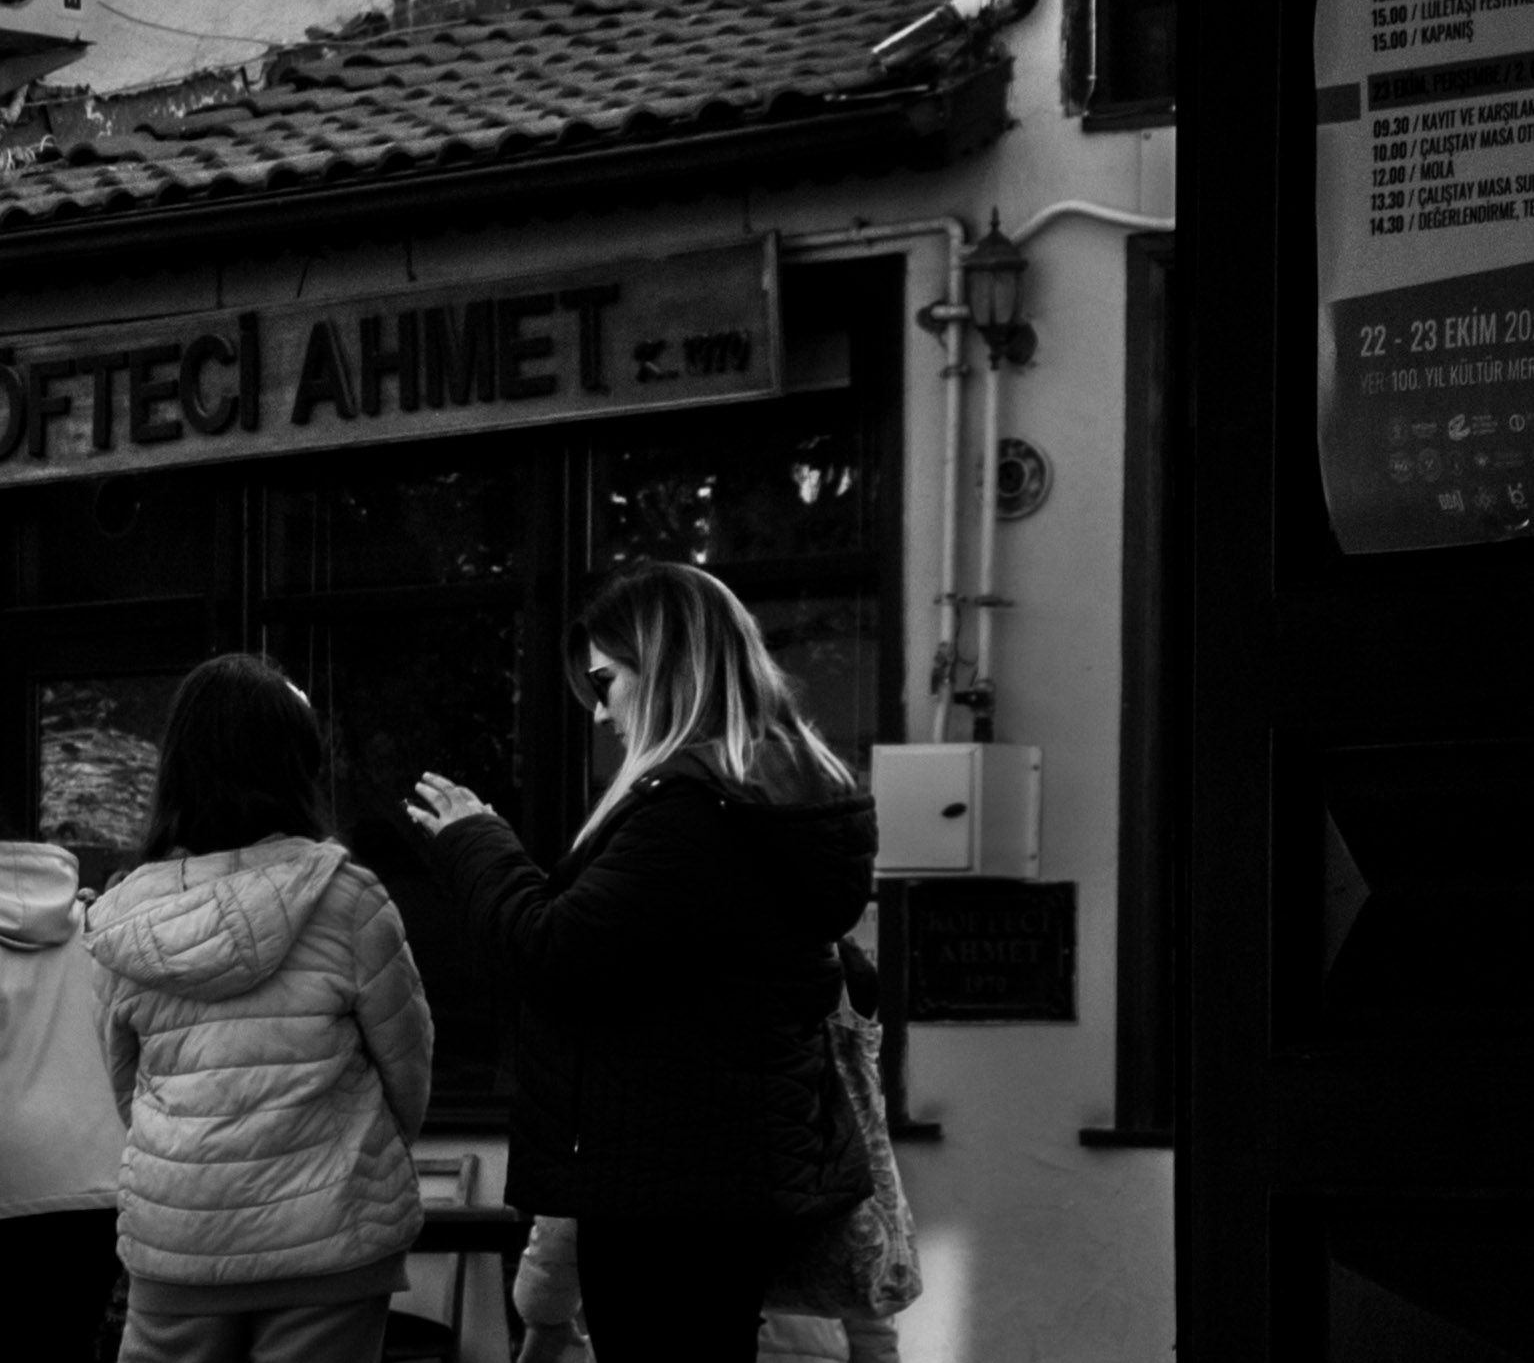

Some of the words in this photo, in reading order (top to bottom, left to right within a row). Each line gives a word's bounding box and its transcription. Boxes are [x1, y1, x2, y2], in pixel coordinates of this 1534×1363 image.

[1372, 5, 1407, 27] 15.00
[1372, 30, 1407, 52] 15.00
[1421, 20, 1474, 44] KAPANIŞ
[1373, 81, 1390, 102] 23
[1434, 65, 1501, 94] PERŞEMBE
[1373, 116, 1410, 138] 09.30
[1422, 110, 1455, 131] KAYIT
[1460, 107, 1475, 126] VE
[1373, 141, 1407, 163] 10.00
[1420, 133, 1477, 160] ÇALIŞTAY
[1480, 126, 1513, 148] MASA
[1372, 166, 1405, 187] 12.00
[1420, 160, 1454, 180] MOLA
[1371, 191, 1404, 211] 13.30
[1418, 182, 1475, 208] ÇALIŞTAY
[1478, 175, 1511, 197] MASA
[1370, 215, 1404, 236] 14.30
[1360, 324, 1386, 357] 22
[1410, 319, 1437, 353] 23
[1445, 306, 1497, 349] EKİM
[1505, 308, 1534, 343] 20
[291, 282, 620, 426] AHMET
[1392, 367, 1421, 392] 100.
[1425, 365, 1445, 388] YIL
[1450, 355, 1503, 386] KÜLTÜR
